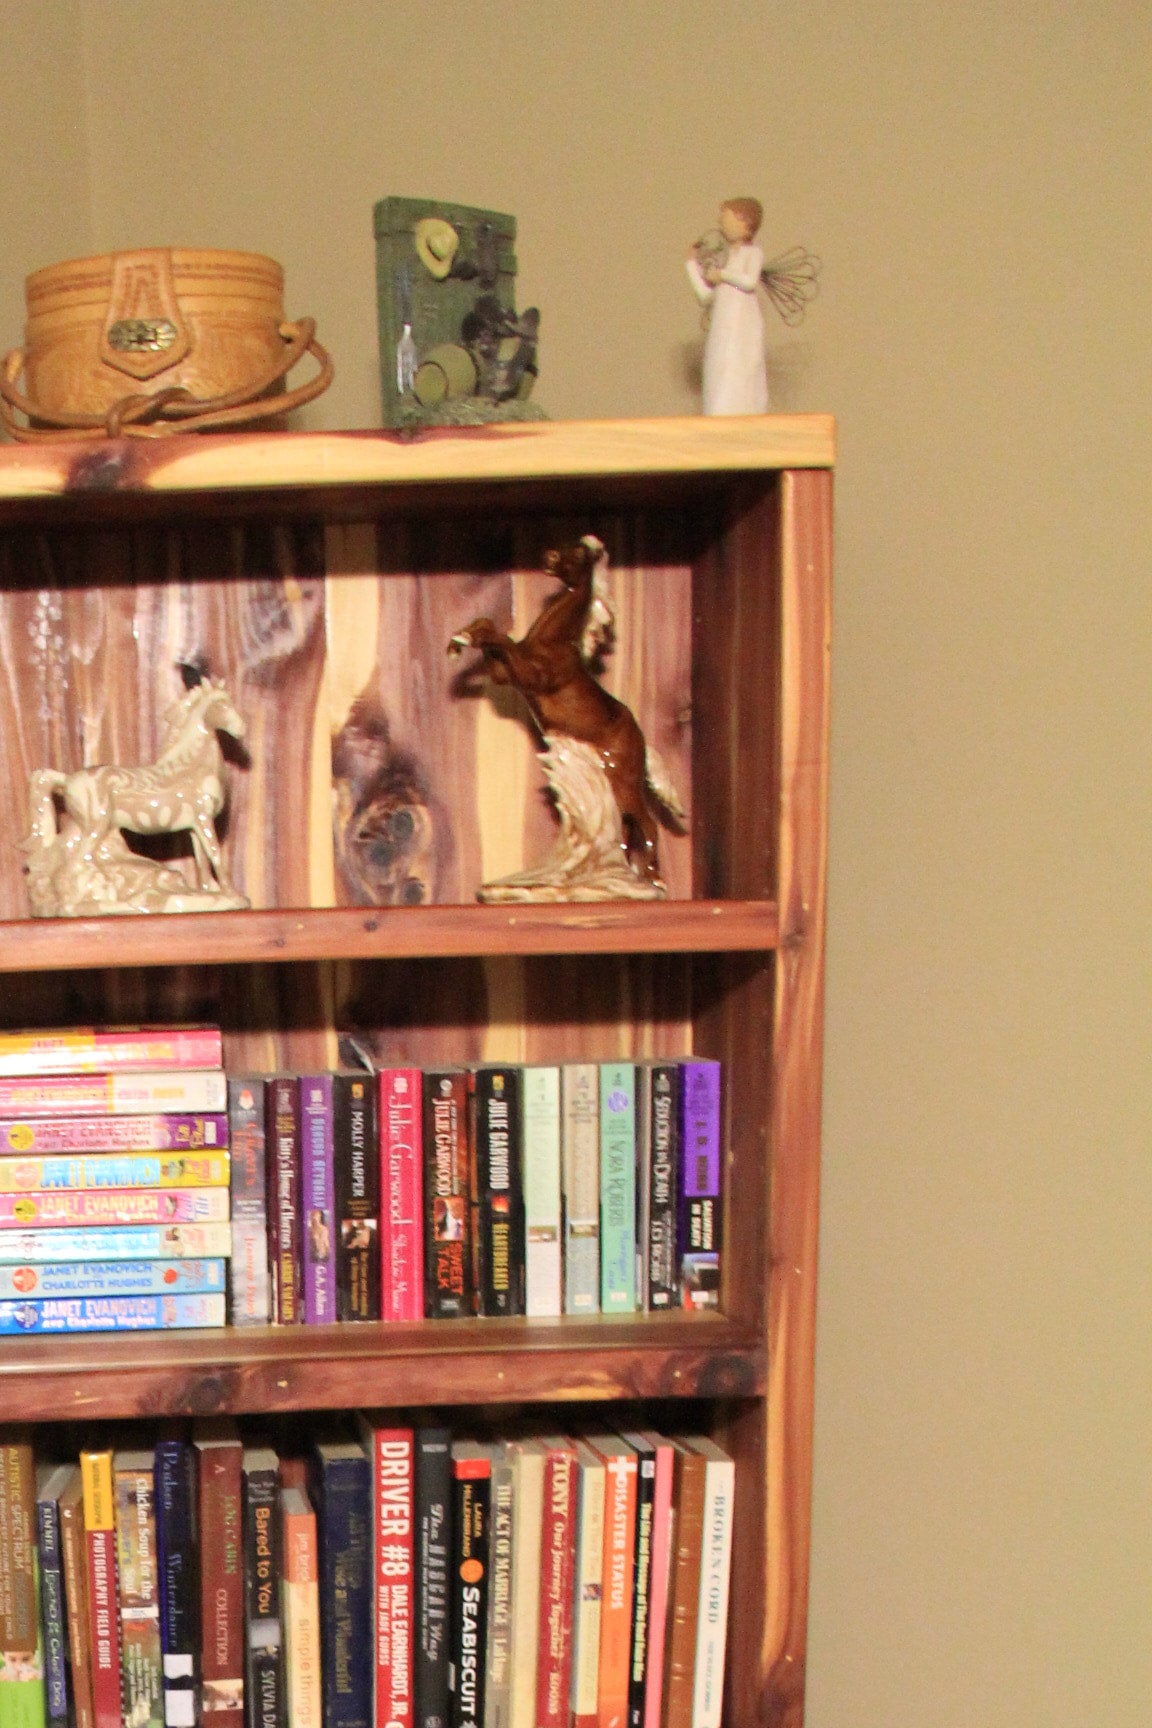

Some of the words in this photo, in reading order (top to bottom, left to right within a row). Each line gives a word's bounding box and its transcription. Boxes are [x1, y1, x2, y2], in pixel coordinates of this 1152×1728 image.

[352, 1111, 364, 1149] MOLLY
[388, 1093, 413, 1141] Julie
[433, 1098, 457, 1132] JULIE
[488, 1098, 509, 1130] JULIE
[352, 1151, 364, 1197] HARPER
[434, 1133, 453, 1196] GARWOOD
[489, 1132, 509, 1190] GARWOOD
[39, 1197, 79, 1212] JANET
[83, 1195, 159, 1211] EVANOVICH
[389, 1144, 414, 1225] Garwood
[655, 1163, 670, 1203] DEATH
[41, 1265, 79, 1275] JANET
[83, 1263, 153, 1274] EVANOVICH
[41, 1278, 104, 1291] CHARLOTTE
[107, 1277, 153, 1289] HUGHES
[437, 1247, 451, 1290] TALK
[450, 1241, 463, 1295] SWEET
[41, 1301, 80, 1318] JANET
[86, 1299, 157, 1317] EVANOVICH
[7, 1448, 22, 1502] AUTISTIC
[214, 1463, 227, 1476] A
[381, 1441, 411, 1536] DRIVER
[552, 1461, 569, 1518] TONY
[135, 1477, 149, 1525] Chicken
[496, 1485, 512, 1510] THE
[613, 1477, 628, 1550] DISASTER
[10, 1503, 26, 1570] SPECTRUM
[41, 1506, 55, 1552] KIMMEL
[136, 1527, 151, 1557] Soup
[255, 1506, 270, 1557] Bared
[429, 1503, 444, 1540] The
[496, 1511, 511, 1536] ACT
[711, 1495, 726, 1569] BROKEN
[381, 1544, 411, 1577] #8
[496, 1538, 511, 1556] OF
[93, 1532, 108, 1607] PHOTOGRAPHY
[124, 1568, 136, 1594] Soul
[139, 1560, 152, 1580] for
[257, 1559, 270, 1578] to
[610, 1554, 626, 1609] STATUS
[140, 1581, 153, 1600] the
[257, 1581, 272, 1614] You
[378, 1584, 389, 1609] WITH
[391, 1584, 409, 1617] DALE
[707, 1575, 722, 1625] CORD
[96, 1609, 110, 1637] FIELD
[215, 1587, 228, 1666] COLLECTION
[98, 1639, 112, 1669] GUIDE
[297, 1618, 313, 1671] simple
[389, 1619, 409, 1699] EARNHARDT,
[461, 1586, 480, 1716] SEABISCUIT
[261, 1670, 277, 1712] SYLVIA
[299, 1674, 315, 1725] things
[391, 1700, 408, 1720] JR.
